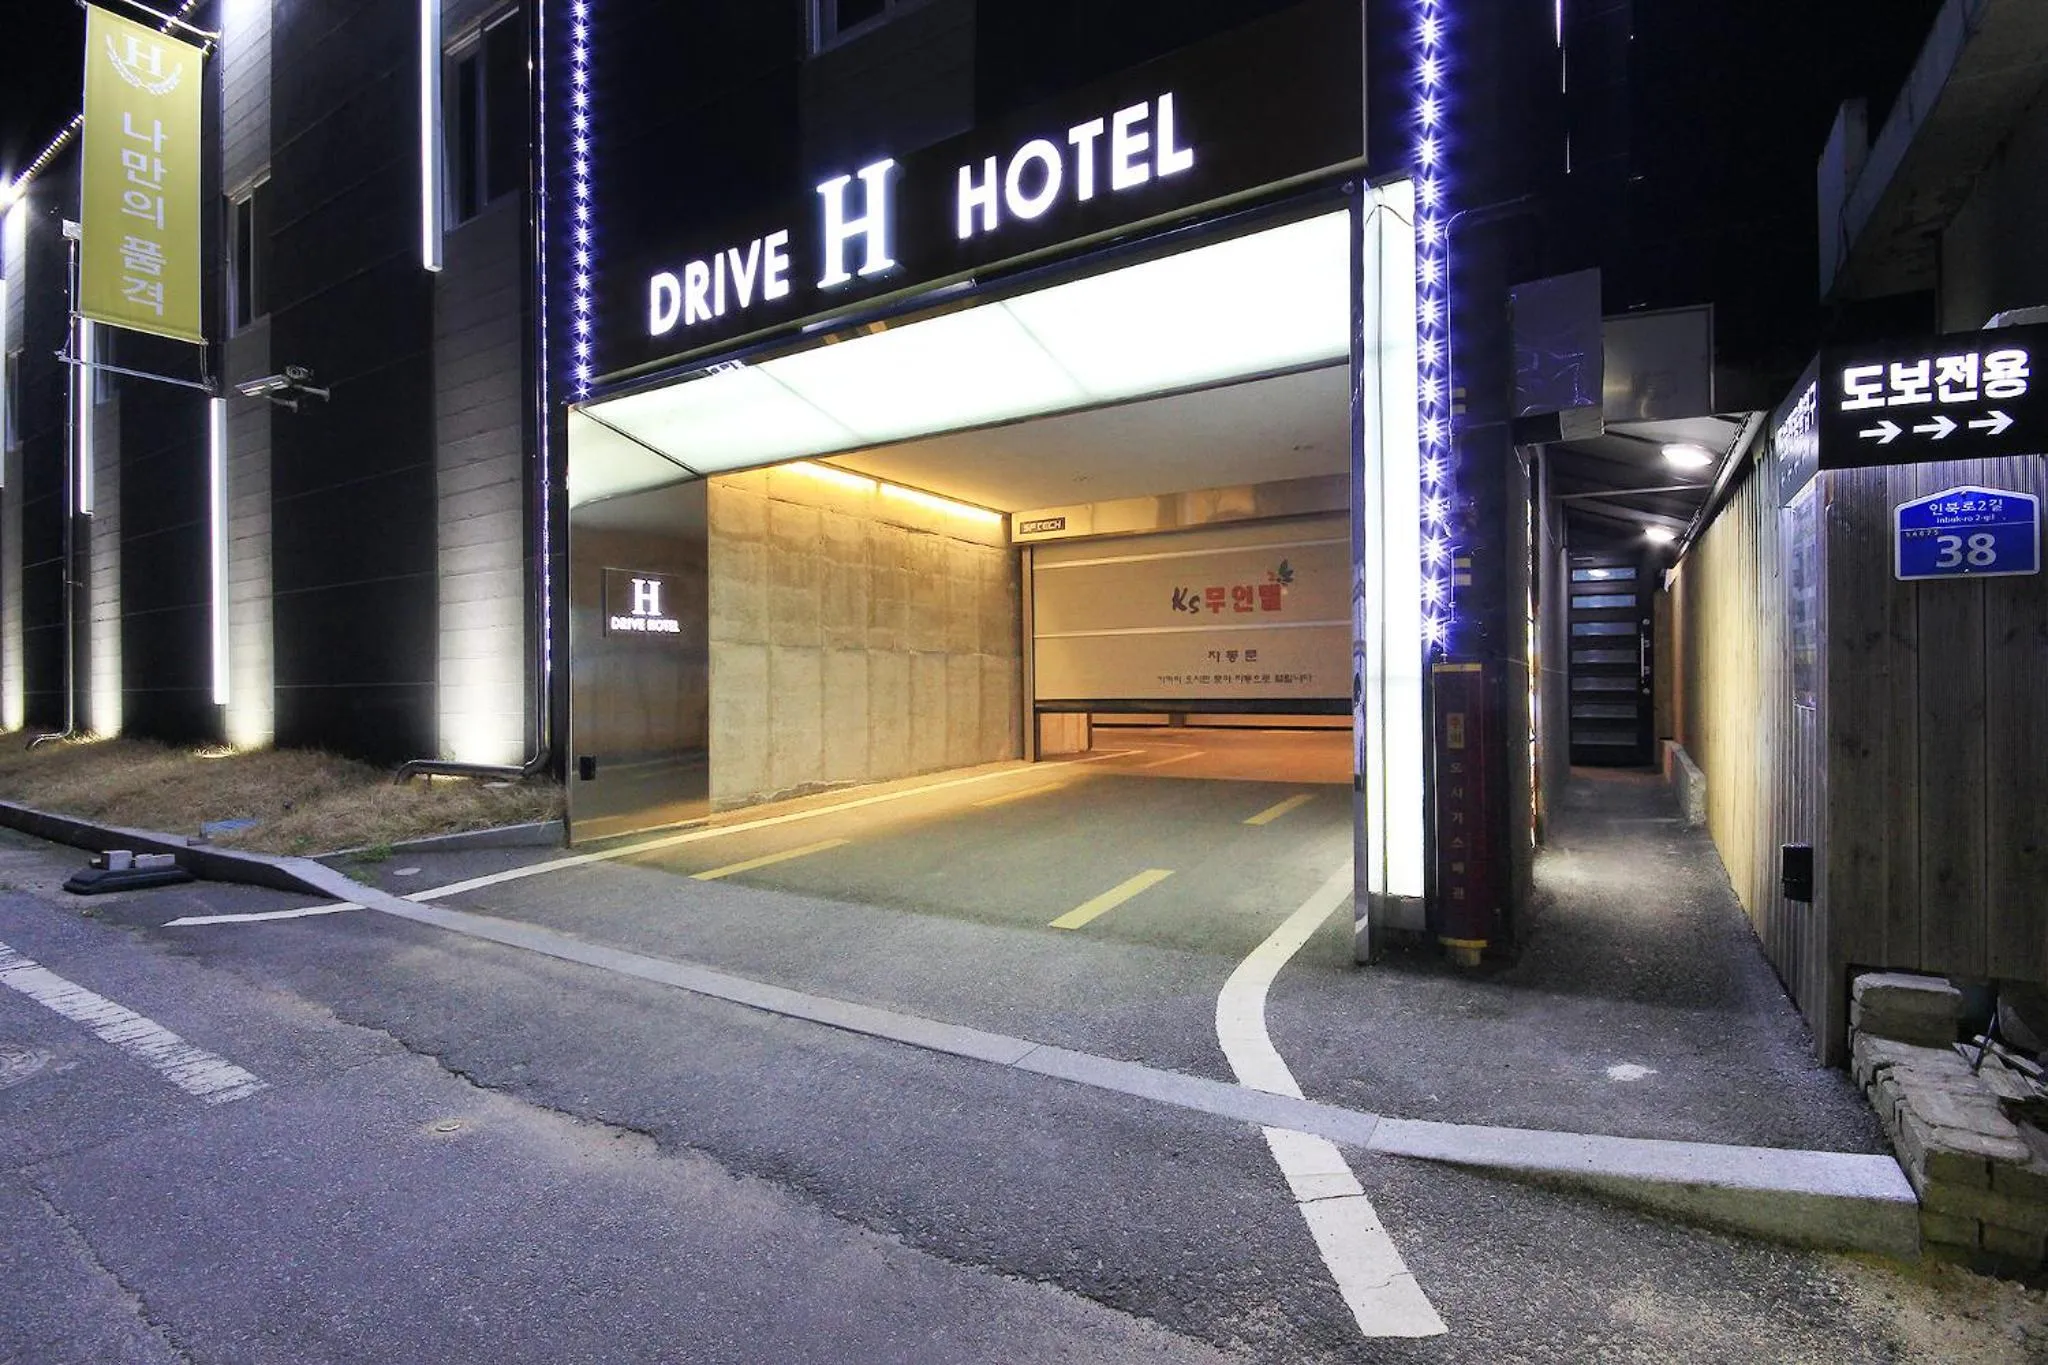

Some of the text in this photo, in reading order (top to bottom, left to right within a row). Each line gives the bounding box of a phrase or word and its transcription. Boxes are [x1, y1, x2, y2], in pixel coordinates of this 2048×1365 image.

[123, 34, 165, 77] H
[119, 112, 168, 316] 나만의 품격
[649, 92, 1194, 336] DRIVE H HOTEL
[1841, 348, 2030, 410] 도보전용
[1929, 499, 2003, 516] 인북로2길
[1935, 532, 1997, 568] 38
[631, 578, 662, 616] H
[611, 616, 681, 632] DRIVE HOTEL
[1207, 649, 1257, 664] 자동문
